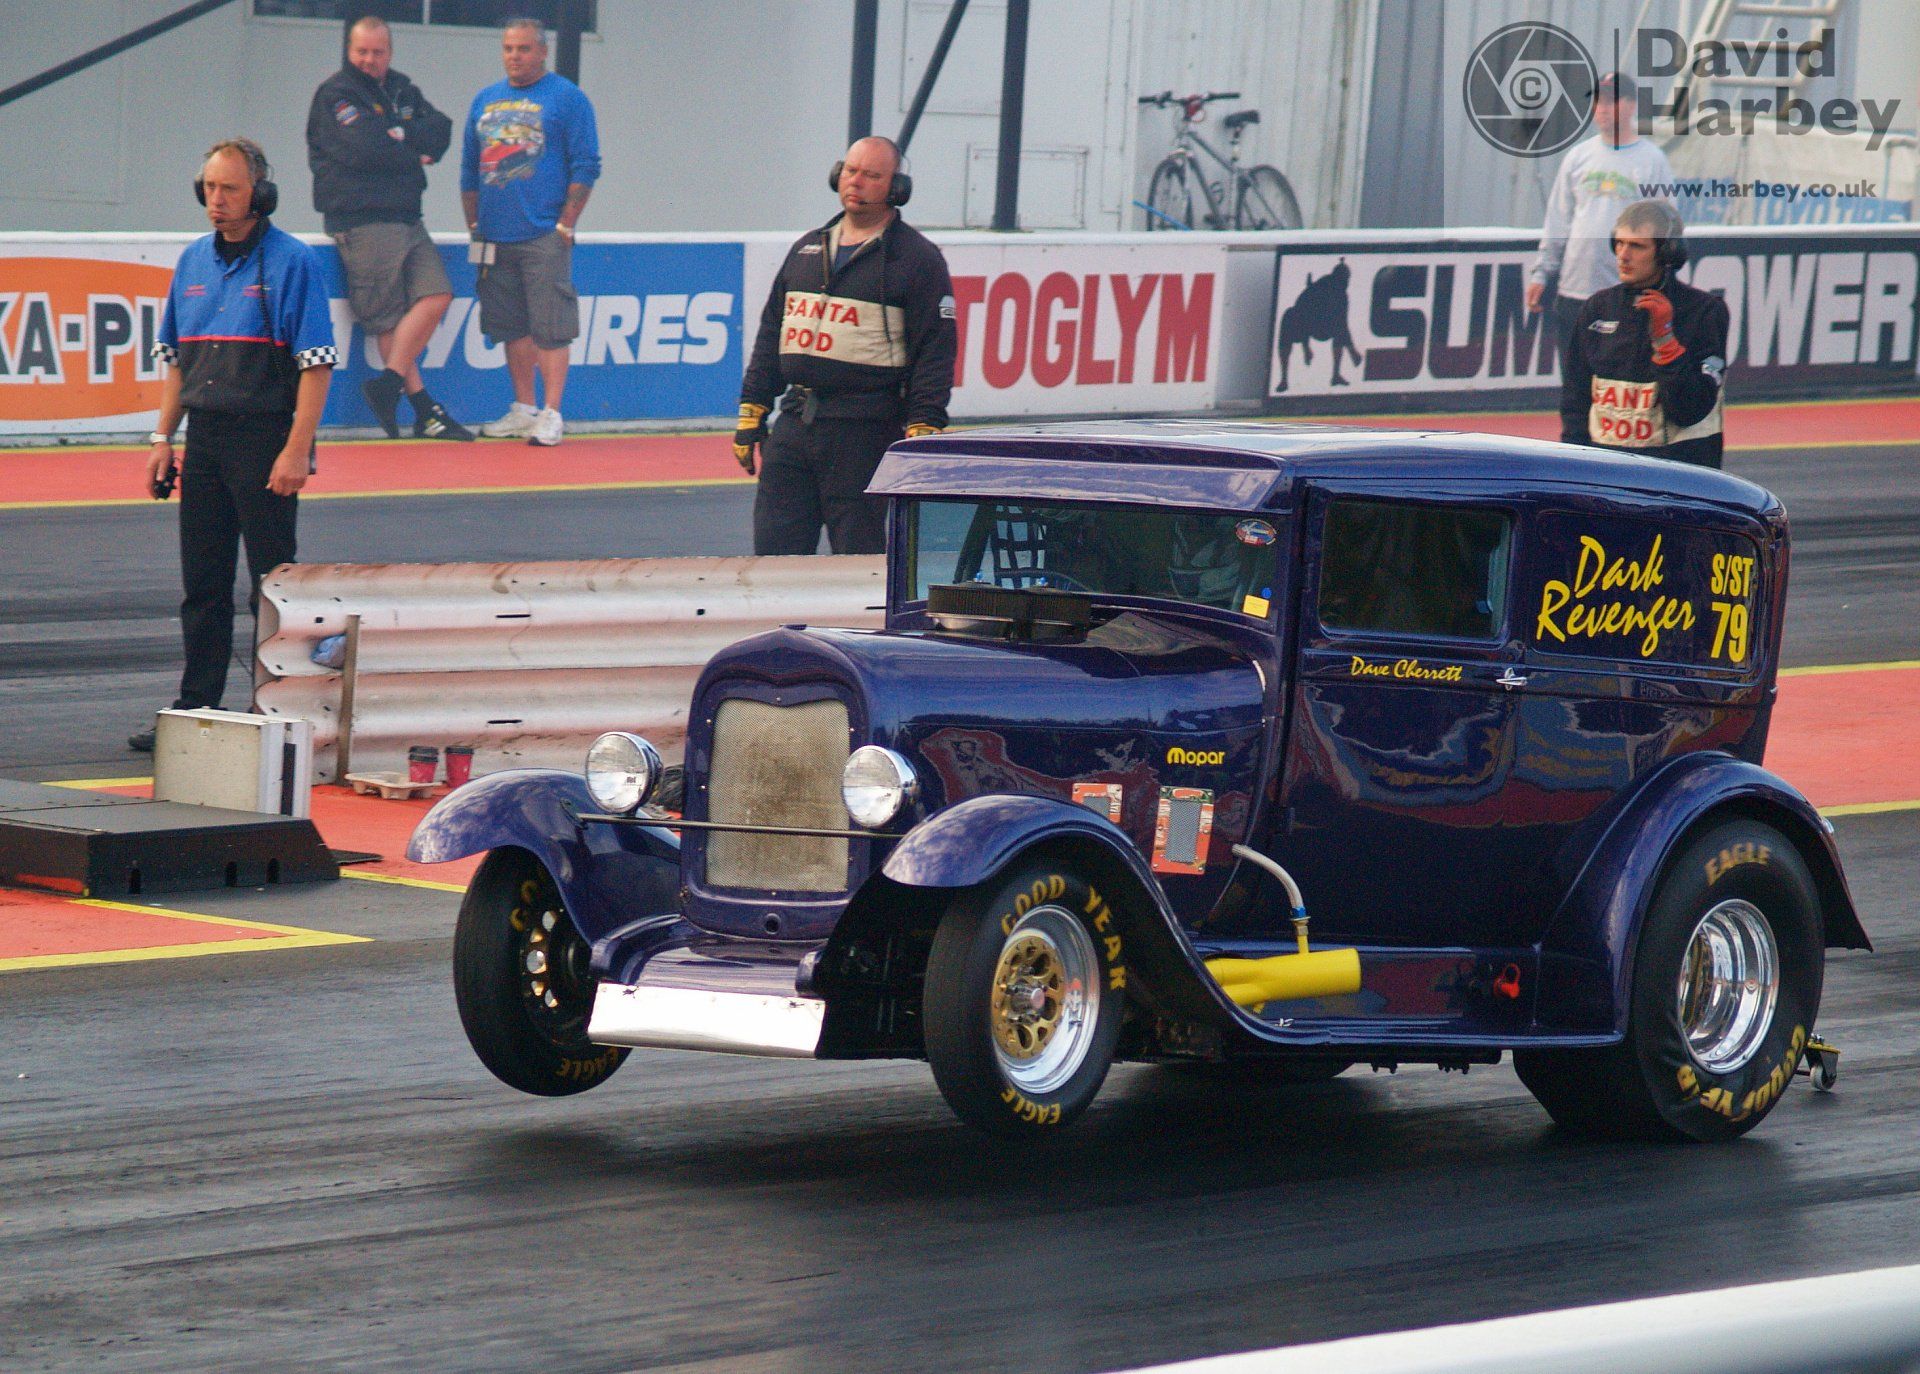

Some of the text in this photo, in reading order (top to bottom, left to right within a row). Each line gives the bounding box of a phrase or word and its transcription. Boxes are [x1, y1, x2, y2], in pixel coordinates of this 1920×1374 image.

[568, 292, 734, 365] IRES
[783, 297, 861, 327] SANTA
[951, 271, 1215, 389] TOGLYM
[1363, 263, 1563, 381] SUM
[1676, 252, 1918, 367] OWER
[785, 327, 834, 352] POD
[1600, 416, 1654, 440] POD
[1574, 533, 1664, 599] Dark
[1710, 553, 1754, 597] S/ST
[1536, 579, 1696, 657] Revenger
[1710, 601, 1748, 663] 79
[1351, 655, 1463, 682] Dave Cherrett
[1166, 747, 1226, 766] Mopar
[1704, 842, 1771, 887] EAGLE
[1000, 874, 1127, 991] GOOD YEAR
[1000, 1086, 1062, 1125] EAGLE
